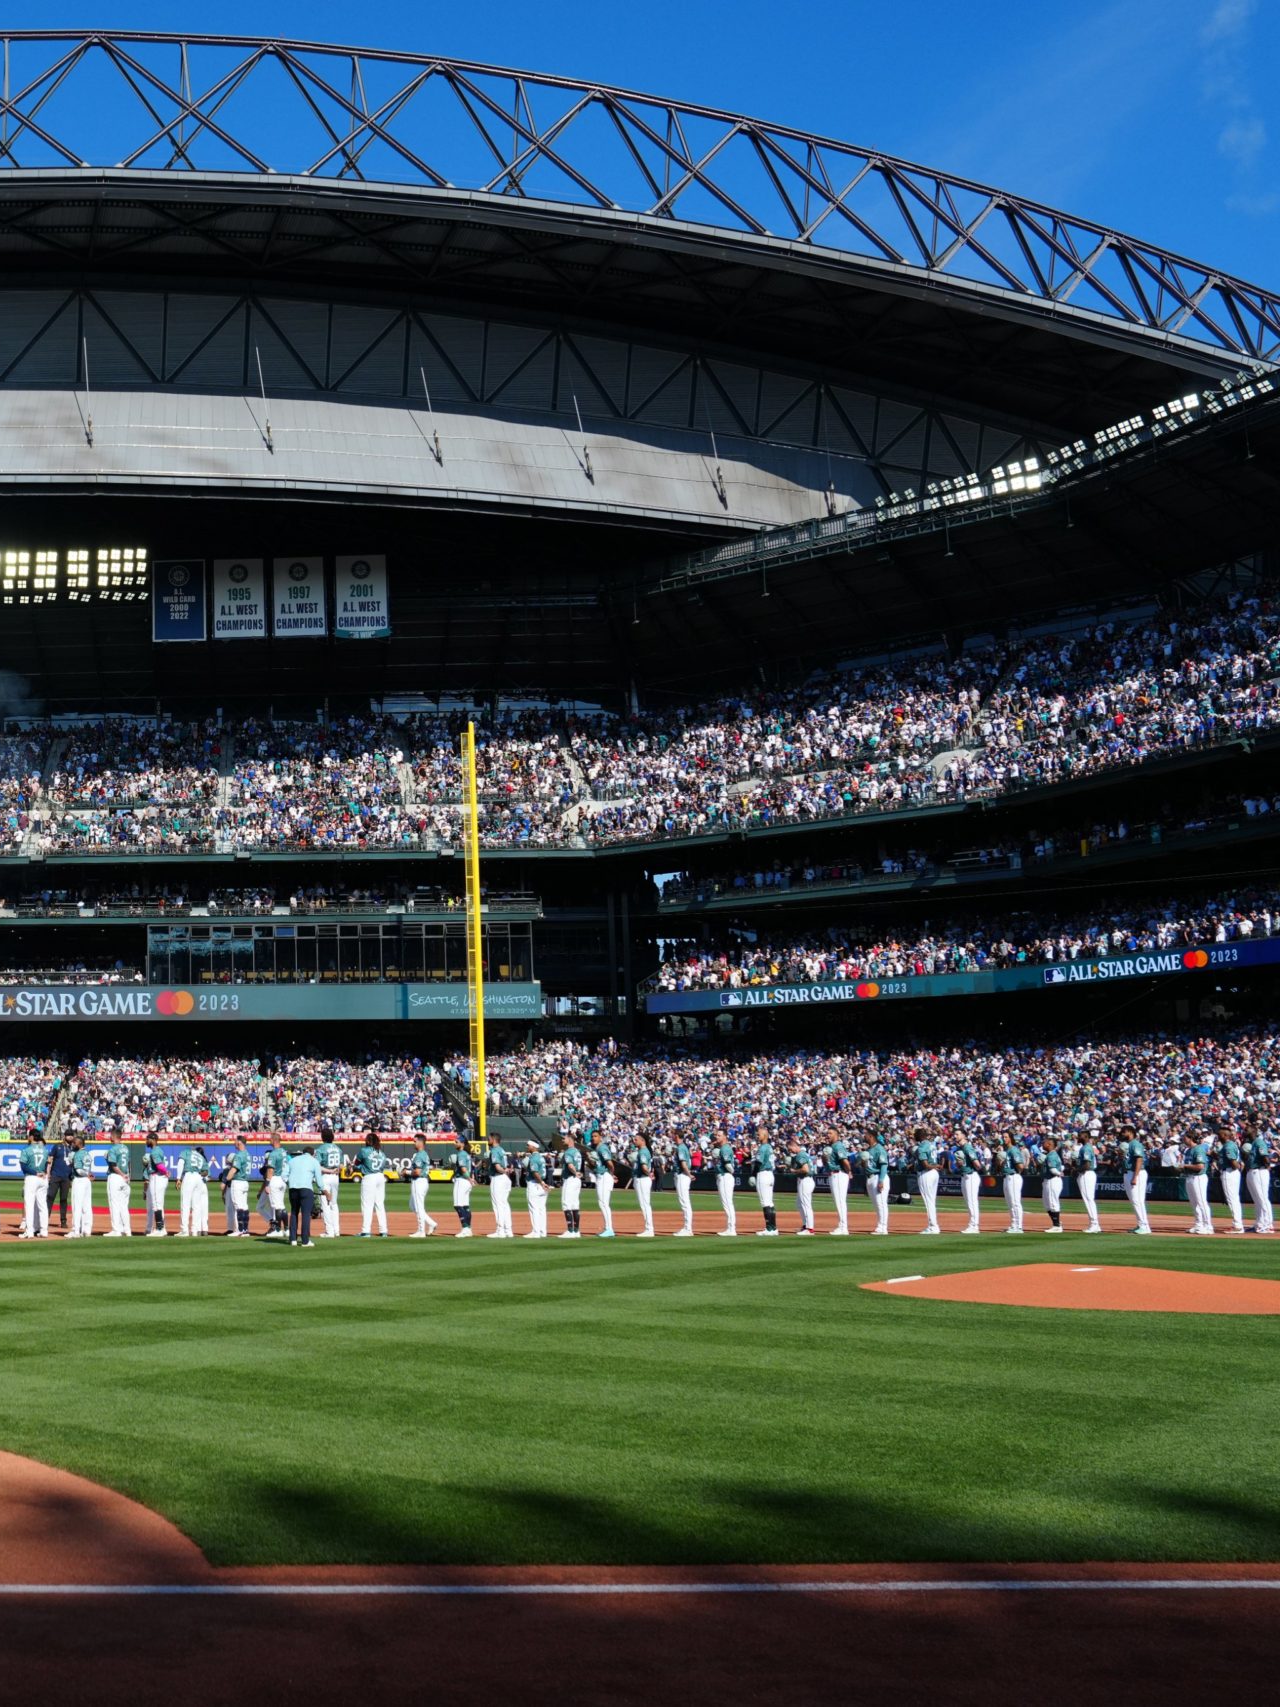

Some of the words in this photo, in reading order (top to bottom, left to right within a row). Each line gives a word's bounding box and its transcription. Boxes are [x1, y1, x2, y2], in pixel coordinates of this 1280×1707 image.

[227, 587, 251, 601] 1995
[288, 586, 310, 599] 1997
[350, 584, 374, 597] 2001
[163, 595, 178, 604] WILD
[179, 595, 196, 603] CARD
[220, 605, 235, 616] A.L.
[236, 604, 258, 615] WEST
[280, 603, 294, 614] A.L.
[296, 602, 318, 613] WEST
[343, 601, 356, 612] A.L.
[358, 601, 381, 612] WEST
[169, 612, 189, 620] 2022
[338, 616, 386, 628] CHAMPIONS
[216, 619, 263, 631] CHAMPIONS
[276, 617, 323, 629] CHAMPIONS
[1135, 954, 1182, 974] GAME
[1210, 949, 1238, 963] 2023
[810, 985, 854, 1001] GAME
[882, 983, 907, 994] 2023
[79, 991, 152, 1015] GAME
[199, 994, 239, 1011] 2023
[409, 992, 459, 1006] SEATTLE,
[463, 994, 536, 1006] WSHINGTON
[470, 1143, 481, 1155] 26
[34, 1154, 44, 1168] 17
[190, 1154, 204, 1169] 53
[327, 1153, 340, 1167] 68
[371, 1158, 384, 1170] 27
[1095, 1182, 1125, 1192] TTRESS
